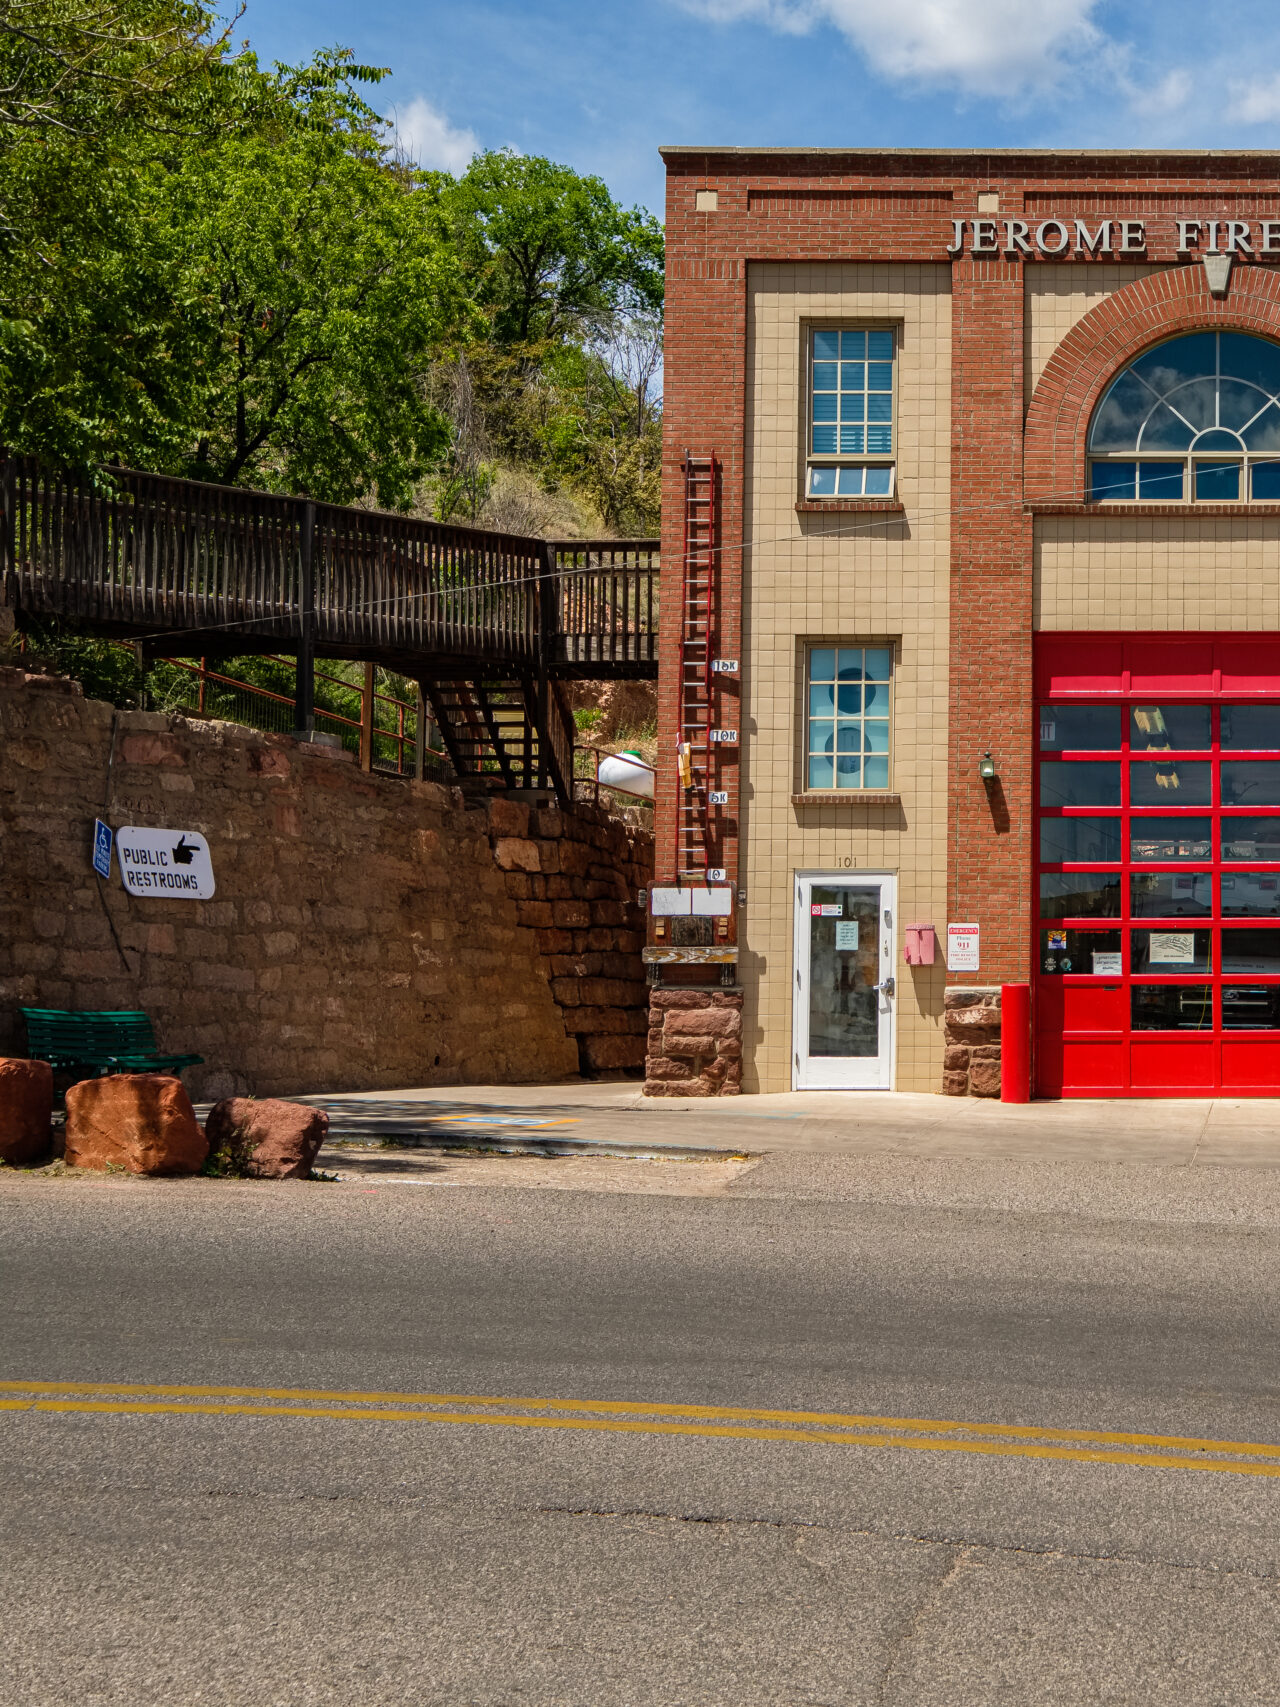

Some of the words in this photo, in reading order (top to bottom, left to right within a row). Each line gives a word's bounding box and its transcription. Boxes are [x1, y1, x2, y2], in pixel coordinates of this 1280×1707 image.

[947, 220, 1147, 254] JEROME
[715, 660, 736, 672] 15K
[714, 730, 736, 742] 10K
[711, 792, 726, 803] 5K
[123, 848, 168, 866] PUBLIC
[838, 856, 857, 868] 101
[127, 870, 199, 890] RESTROOMS
